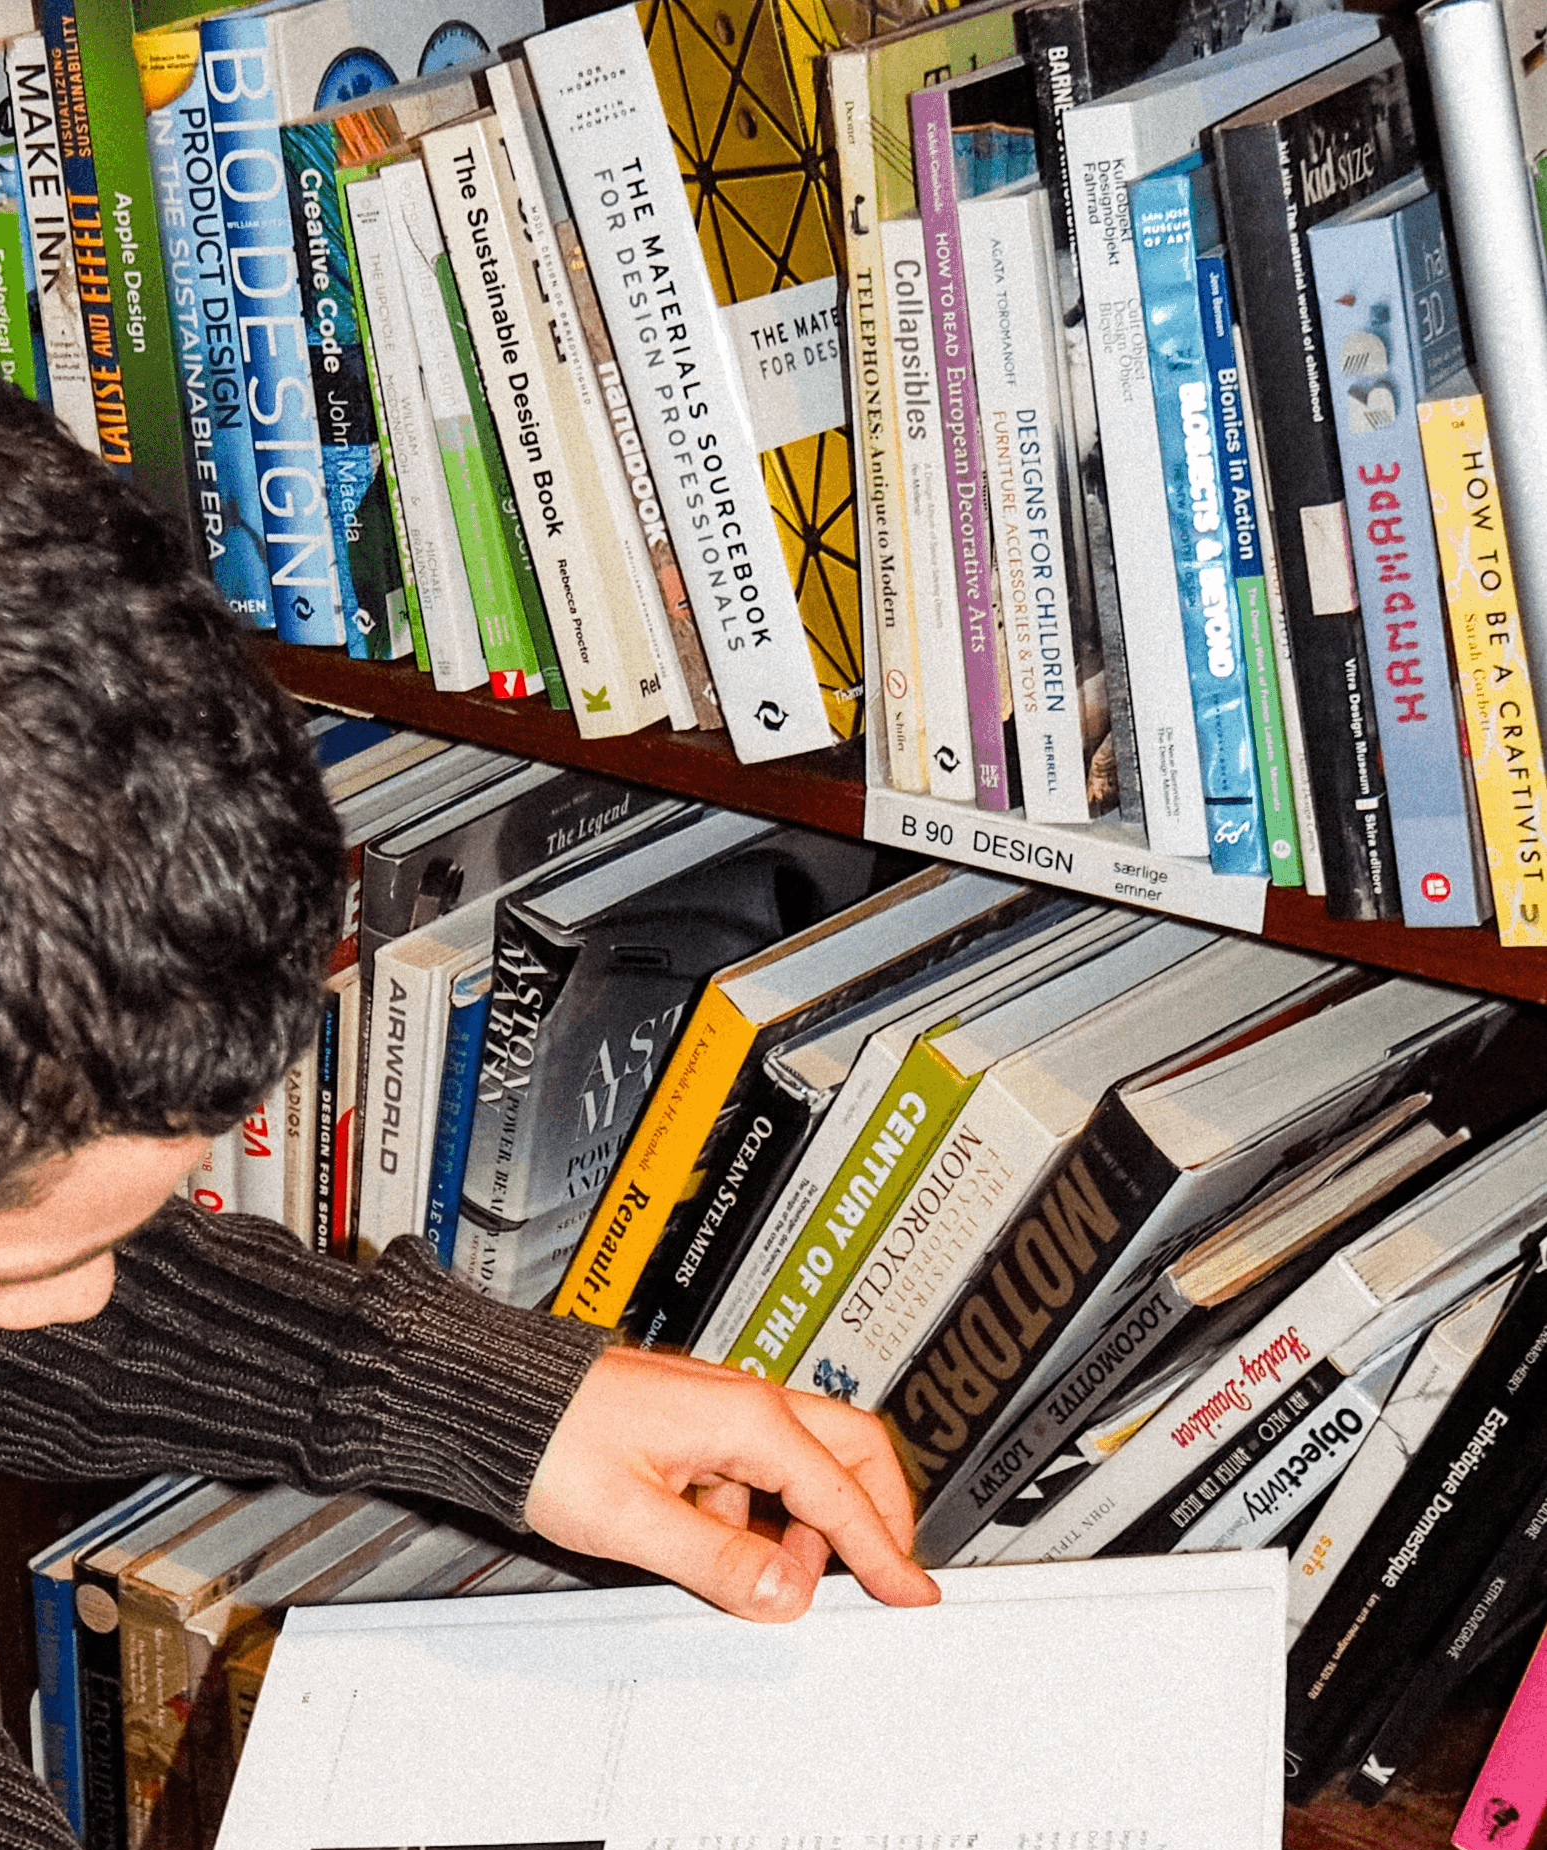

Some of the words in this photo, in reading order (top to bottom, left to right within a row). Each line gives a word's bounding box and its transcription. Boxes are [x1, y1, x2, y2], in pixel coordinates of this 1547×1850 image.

[52, 47, 75, 158] VISUALIZING
[62, 15, 93, 158] SUSTAINABILITY
[14, 61, 60, 200] MAKE
[159, 157, 186, 230] THE
[179, 106, 226, 288] PRODUCT
[1083, 162, 1102, 226] Fahrrad
[1097, 160, 1120, 266] Designobjekt
[1112, 158, 1134, 244] Kultobjekt
[1299, 146, 1336, 208] kid
[1337, 141, 1376, 190] size
[67, 187, 112, 304] EFFECT
[112, 190, 143, 266] Apple
[298, 167, 332, 291] Creative
[935, 231, 956, 269] HOW
[1142, 220, 1191, 235] MUSEUM
[1284, 202, 1301, 231] The
[990, 238, 1009, 284] AGATA
[1286, 232, 1309, 291] material
[88, 312, 114, 359] AND
[120, 270, 149, 354] Design
[204, 46, 336, 589] BIODESIGN
[316, 298, 342, 375] Code
[452, 147, 478, 203] The
[466, 206, 521, 367] Sustainable
[507, 371, 544, 464] Design
[532, 468, 564, 540] Book
[749, 327, 787, 352] THE
[893, 258, 929, 441] Collapsibles
[940, 302, 959, 358] READ
[996, 290, 1019, 387] TOROMANOFF
[1294, 292, 1314, 334] world
[168, 237, 217, 485] SUSTAINABLE
[202, 298, 244, 430] DESIGN
[758, 354, 799, 381] FOR
[855, 269, 886, 440] TELEPHONES:
[1301, 354, 1327, 423] childhood
[327, 389, 350, 453] John
[592, 168, 627, 232] FOR
[615, 246, 665, 370] DESIGN
[654, 383, 748, 654] PROFESSIONALS
[621, 156, 655, 221] THE
[640, 233, 710, 421] MATERIALS
[697, 434, 773, 649] SOURCEBOOK
[947, 365, 970, 476] European
[336, 457, 363, 544] Maeda
[869, 443, 890, 516] Antique
[1015, 408, 1050, 518] DESIGNS
[1217, 367, 1242, 454] Bionics
[1233, 491, 1255, 561] Action
[1463, 450, 1496, 532] HOW
[200, 488, 227, 562] ERA
[955, 480, 983, 606] Decorative
[1028, 526, 1053, 581] FOR
[878, 541, 898, 629] Modern
[1477, 548, 1504, 593] TO
[557, 557, 578, 616] Rebecca
[573, 616, 591, 667] Proctor
[965, 606, 986, 654] Arts
[1004, 523, 1029, 644] ACCESSORIES
[1020, 664, 1038, 714] TOYS
[1033, 587, 1066, 713] CHILDREN
[1198, 567, 1236, 679] BEYOND
[1463, 612, 1483, 663] Sarah
[1486, 611, 1510, 647] BE
[1342, 657, 1360, 692] Vitra
[1345, 692, 1366, 739] Design
[1043, 733, 1058, 795] MERRELL
[1353, 740, 1374, 795] Museum
[1498, 702, 1544, 884] CRAFTIVIST
[545, 826, 575, 857] The
[576, 793, 631, 841] Legend
[900, 814, 919, 838] B
[924, 820, 955, 847] 90
[972, 829, 1075, 875] DESIGN
[1363, 812, 1381, 847] Skira
[1112, 859, 1169, 886] særlige
[1113, 881, 1163, 903] emner
[1367, 848, 1387, 895] editore
[500, 944, 549, 1102] ASTON
[380, 976, 408, 1177] AIRWORLD
[319, 1090, 333, 1158] DESIGN
[723, 1114, 774, 1191] OCEAN
[318, 1162, 331, 1198] FOR
[834, 1091, 927, 1250] CENTURY
[574, 1181, 651, 1295] Renault
[673, 1184, 738, 1289] STEAMERS
[840, 1123, 984, 1334] MOTORCYCLES
[797, 1245, 835, 1298] OF
[753, 1294, 809, 1362] THE
[1051, 1291, 1174, 1427] LOCOMOTIVE
[1170, 1325, 1312, 1451] Harley-Davidson
[973, 1436, 1035, 1510] LOEWY
[1242, 1406, 1365, 1524] Objectivity
[1441, 1405, 1510, 1497] Esthétique
[1081, 1496, 1117, 1531] JOHN
[1379, 1491, 1453, 1591] Domestique
[1301, 1533, 1334, 1578] safe
[1484, 1575, 1508, 1609] KEITH
[1445, 1604, 1490, 1662] LOVEGROVE
